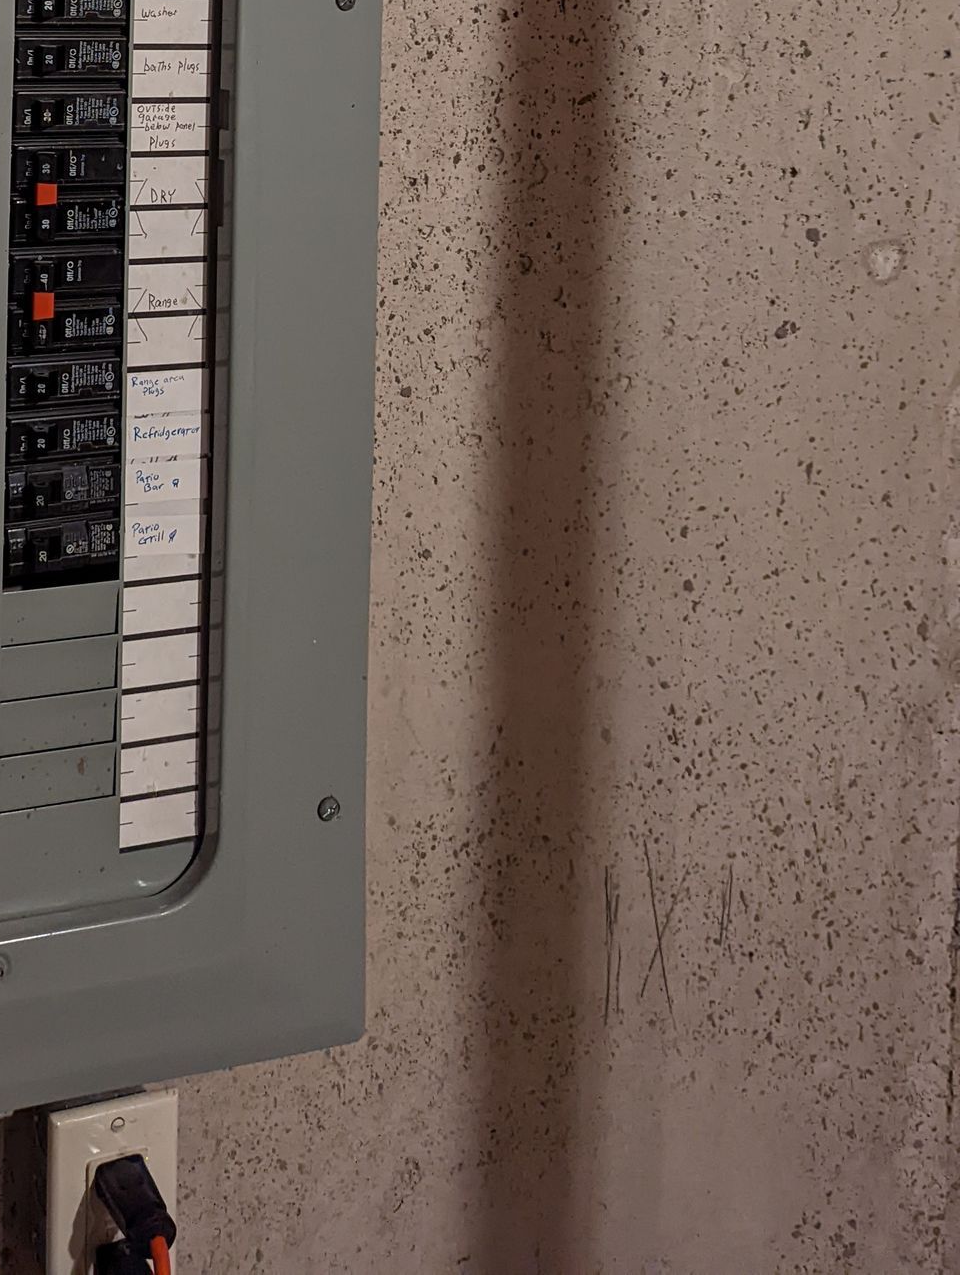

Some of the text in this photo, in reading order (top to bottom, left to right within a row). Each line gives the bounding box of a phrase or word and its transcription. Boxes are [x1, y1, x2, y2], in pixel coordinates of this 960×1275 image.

[44, 0, 53, 11] 20
[45, 55, 53, 64] 20
[144, 59, 171, 73] baths
[138, 113, 176, 122] garage
[42, 163, 50, 174] 30
[151, 188, 176, 203] DRY
[42, 219, 50, 229] 30
[148, 293, 178, 310] Range
[132, 377, 159, 387] Range
[37, 383, 46, 394] 20
[37, 438, 46, 449] 20
[144, 483, 164, 493] Bar
[36, 495, 44, 506] 20
[39, 551, 47, 562] 20
